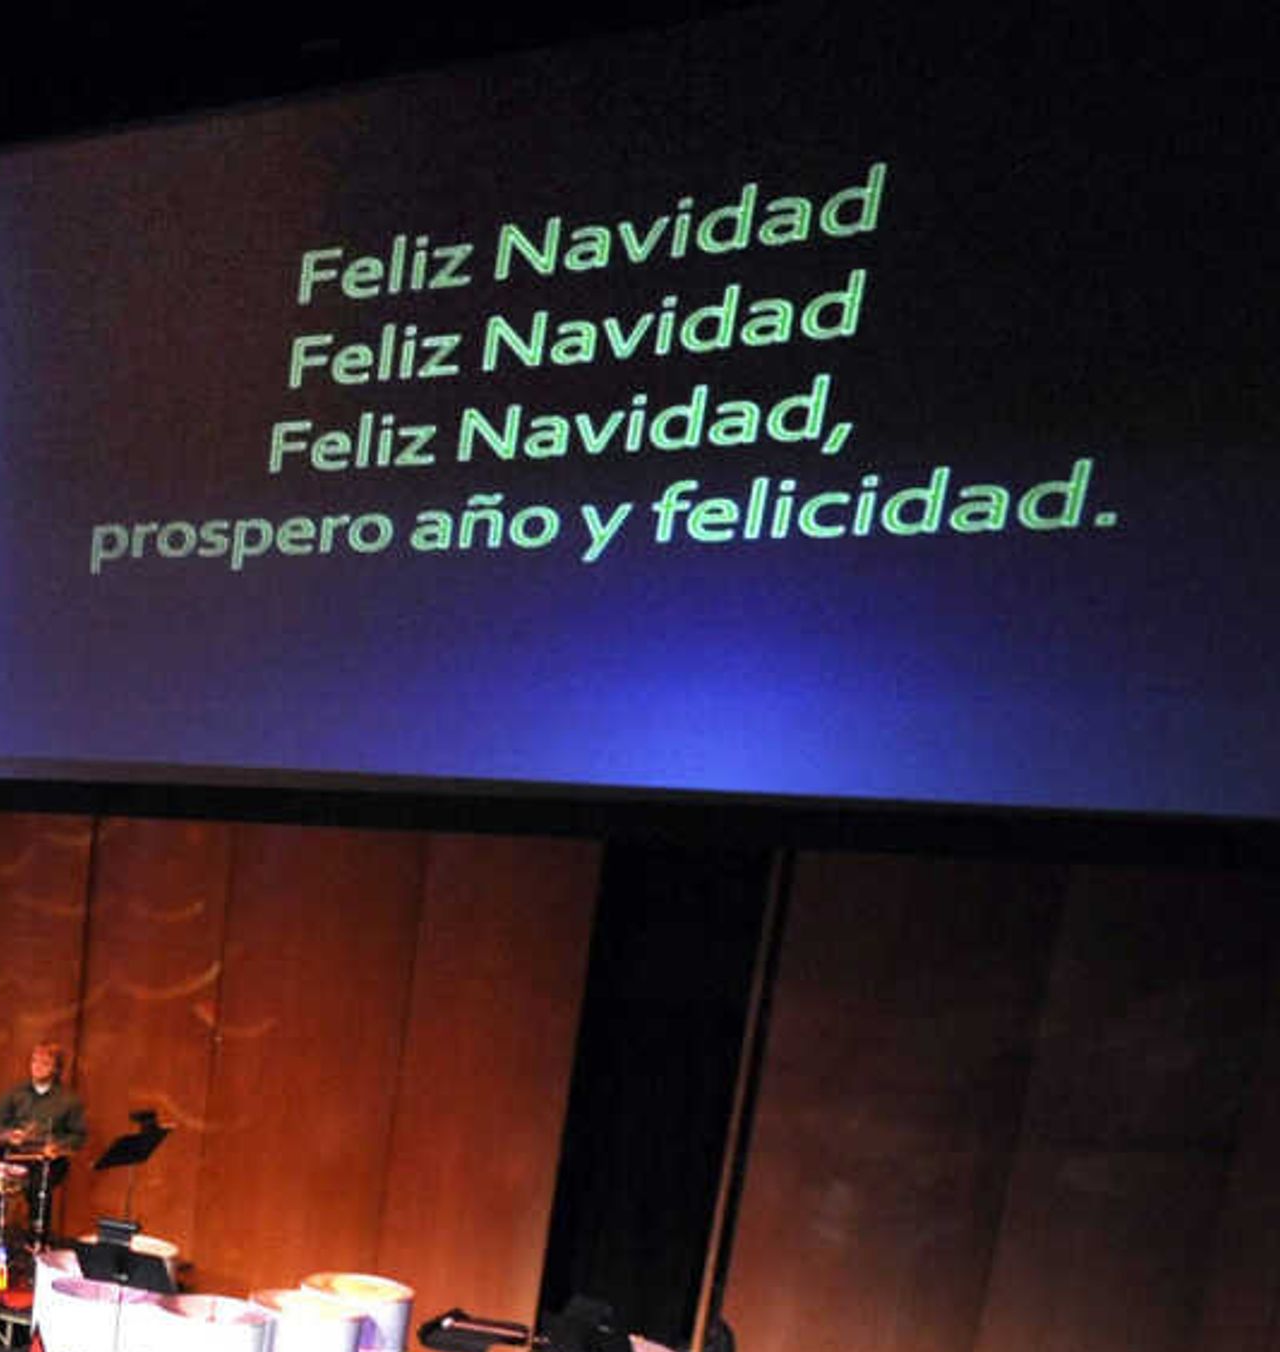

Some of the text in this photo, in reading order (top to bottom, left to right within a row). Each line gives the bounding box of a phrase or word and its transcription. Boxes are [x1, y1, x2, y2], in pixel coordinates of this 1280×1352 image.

[297, 161, 888, 306] Feliz Navidad
[287, 267, 868, 390] Feliz Navidad
[267, 372, 854, 475] Feliz Navidad,
[89, 457, 1118, 574] prospero año y felicidad.
